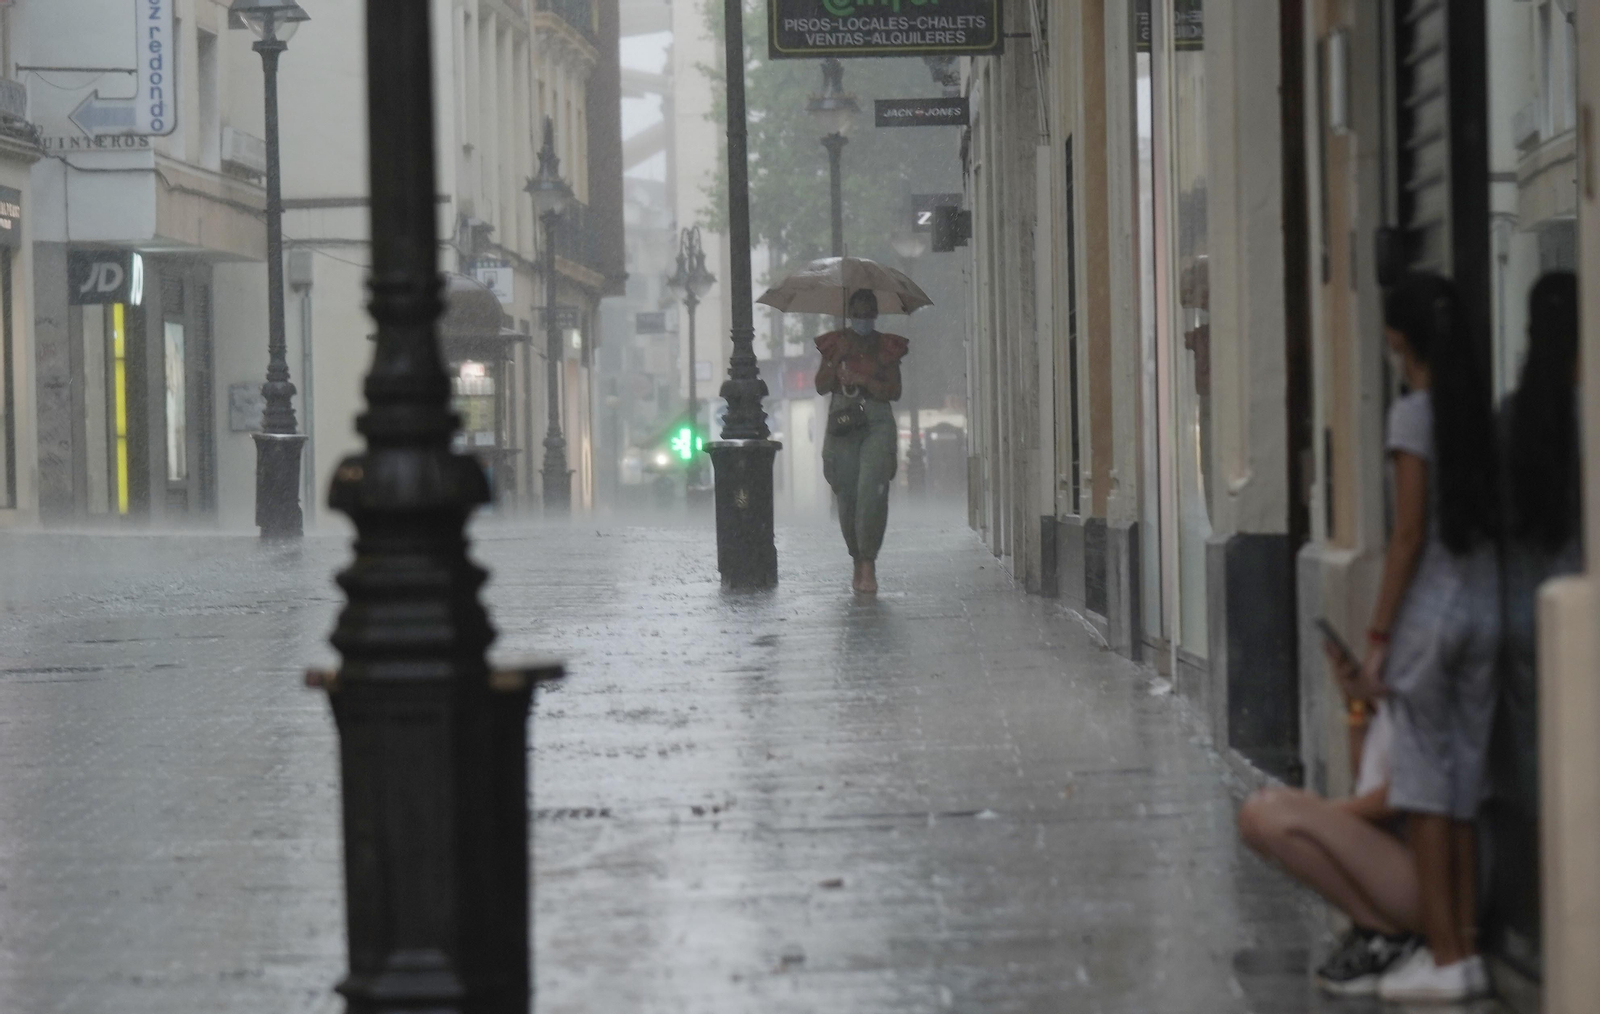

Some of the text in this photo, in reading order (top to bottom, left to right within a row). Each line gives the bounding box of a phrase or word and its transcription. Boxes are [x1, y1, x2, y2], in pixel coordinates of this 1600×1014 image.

[784, 16, 987, 31] PISOS-LOCALES-CHALETS
[805, 31, 966, 46] VENTAS-ALQUILERES
[148, 26, 163, 132] redondo
[883, 107, 913, 118] JACK
[924, 107, 962, 117] JONES
[80, 262, 124, 293] JD
